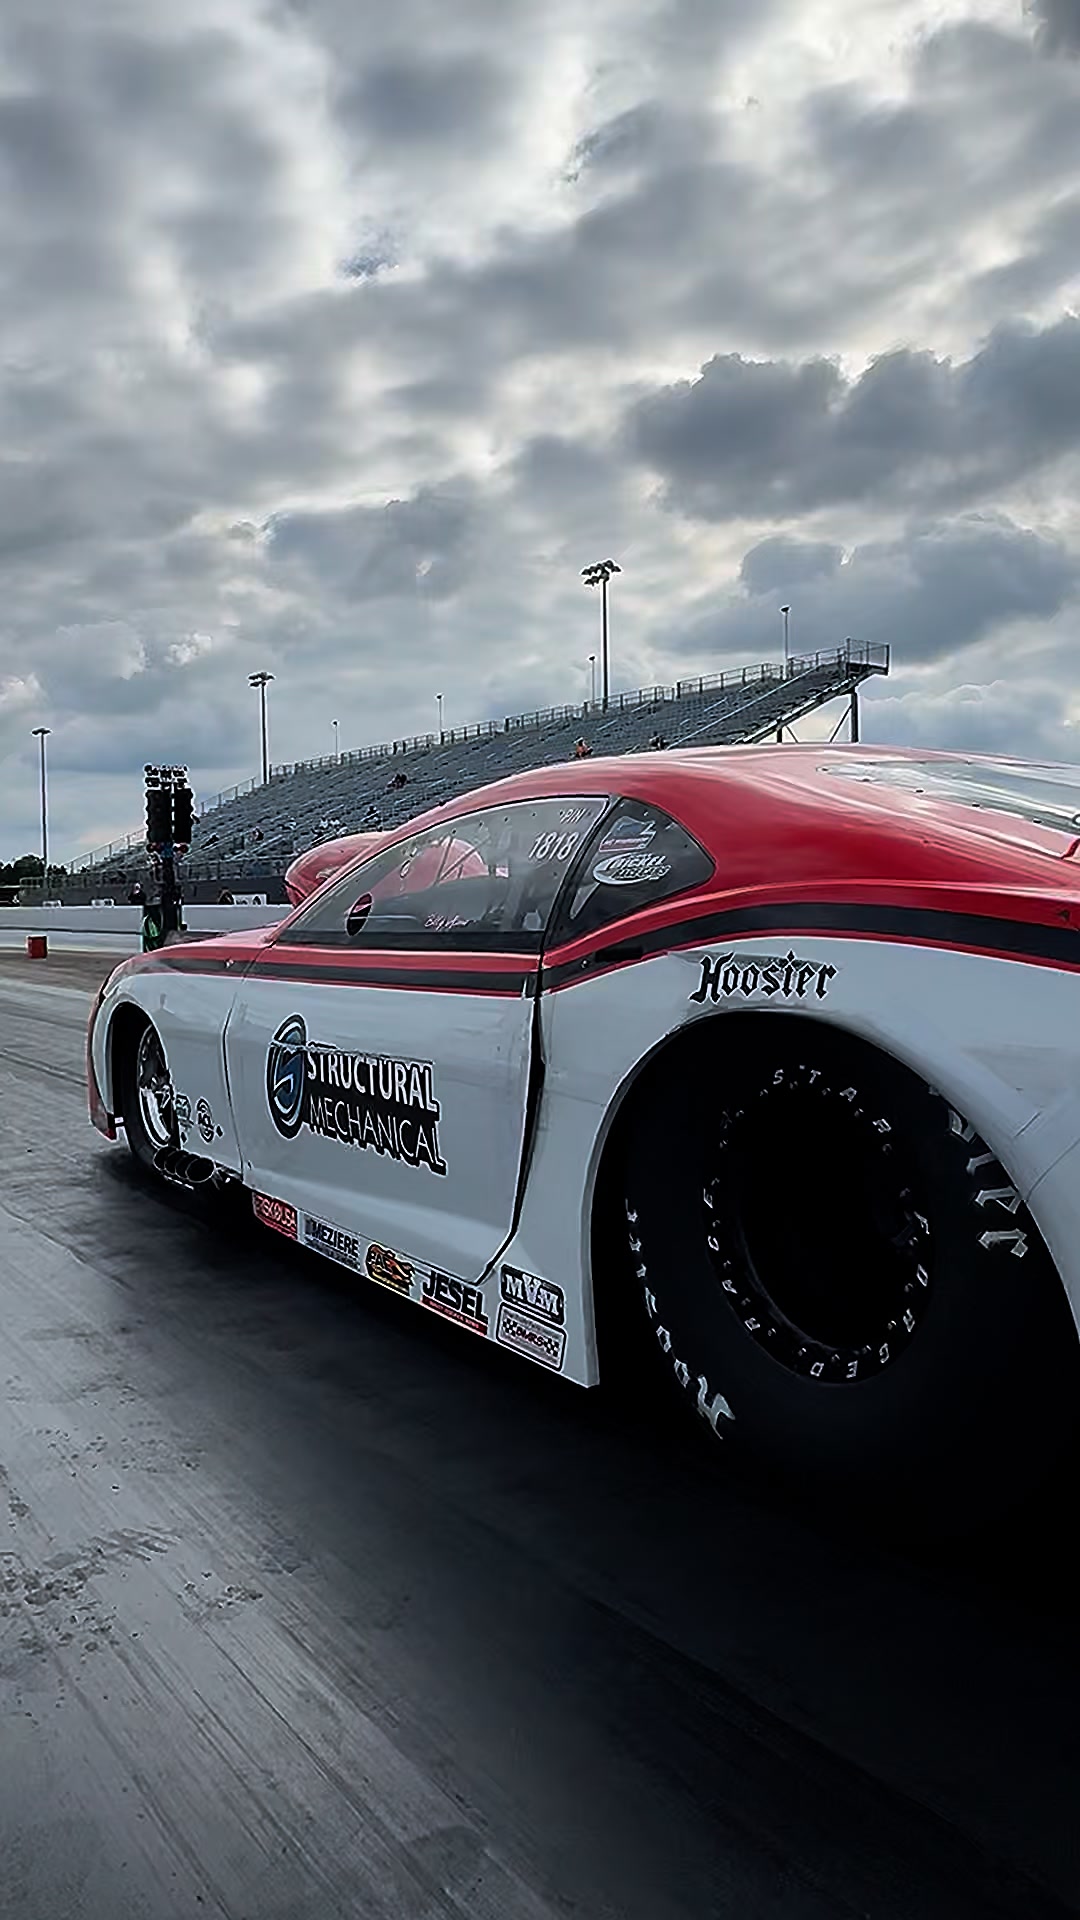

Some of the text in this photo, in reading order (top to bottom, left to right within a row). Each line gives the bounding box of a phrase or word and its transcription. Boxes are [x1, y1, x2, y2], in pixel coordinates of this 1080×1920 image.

[528, 831, 580, 861] 1818
[687, 948, 840, 1005] Hoosier
[307, 1051, 438, 1113] STRUCTURAL
[309, 1094, 444, 1167] MECHANICAL
[421, 1269, 489, 1326] JESEL
